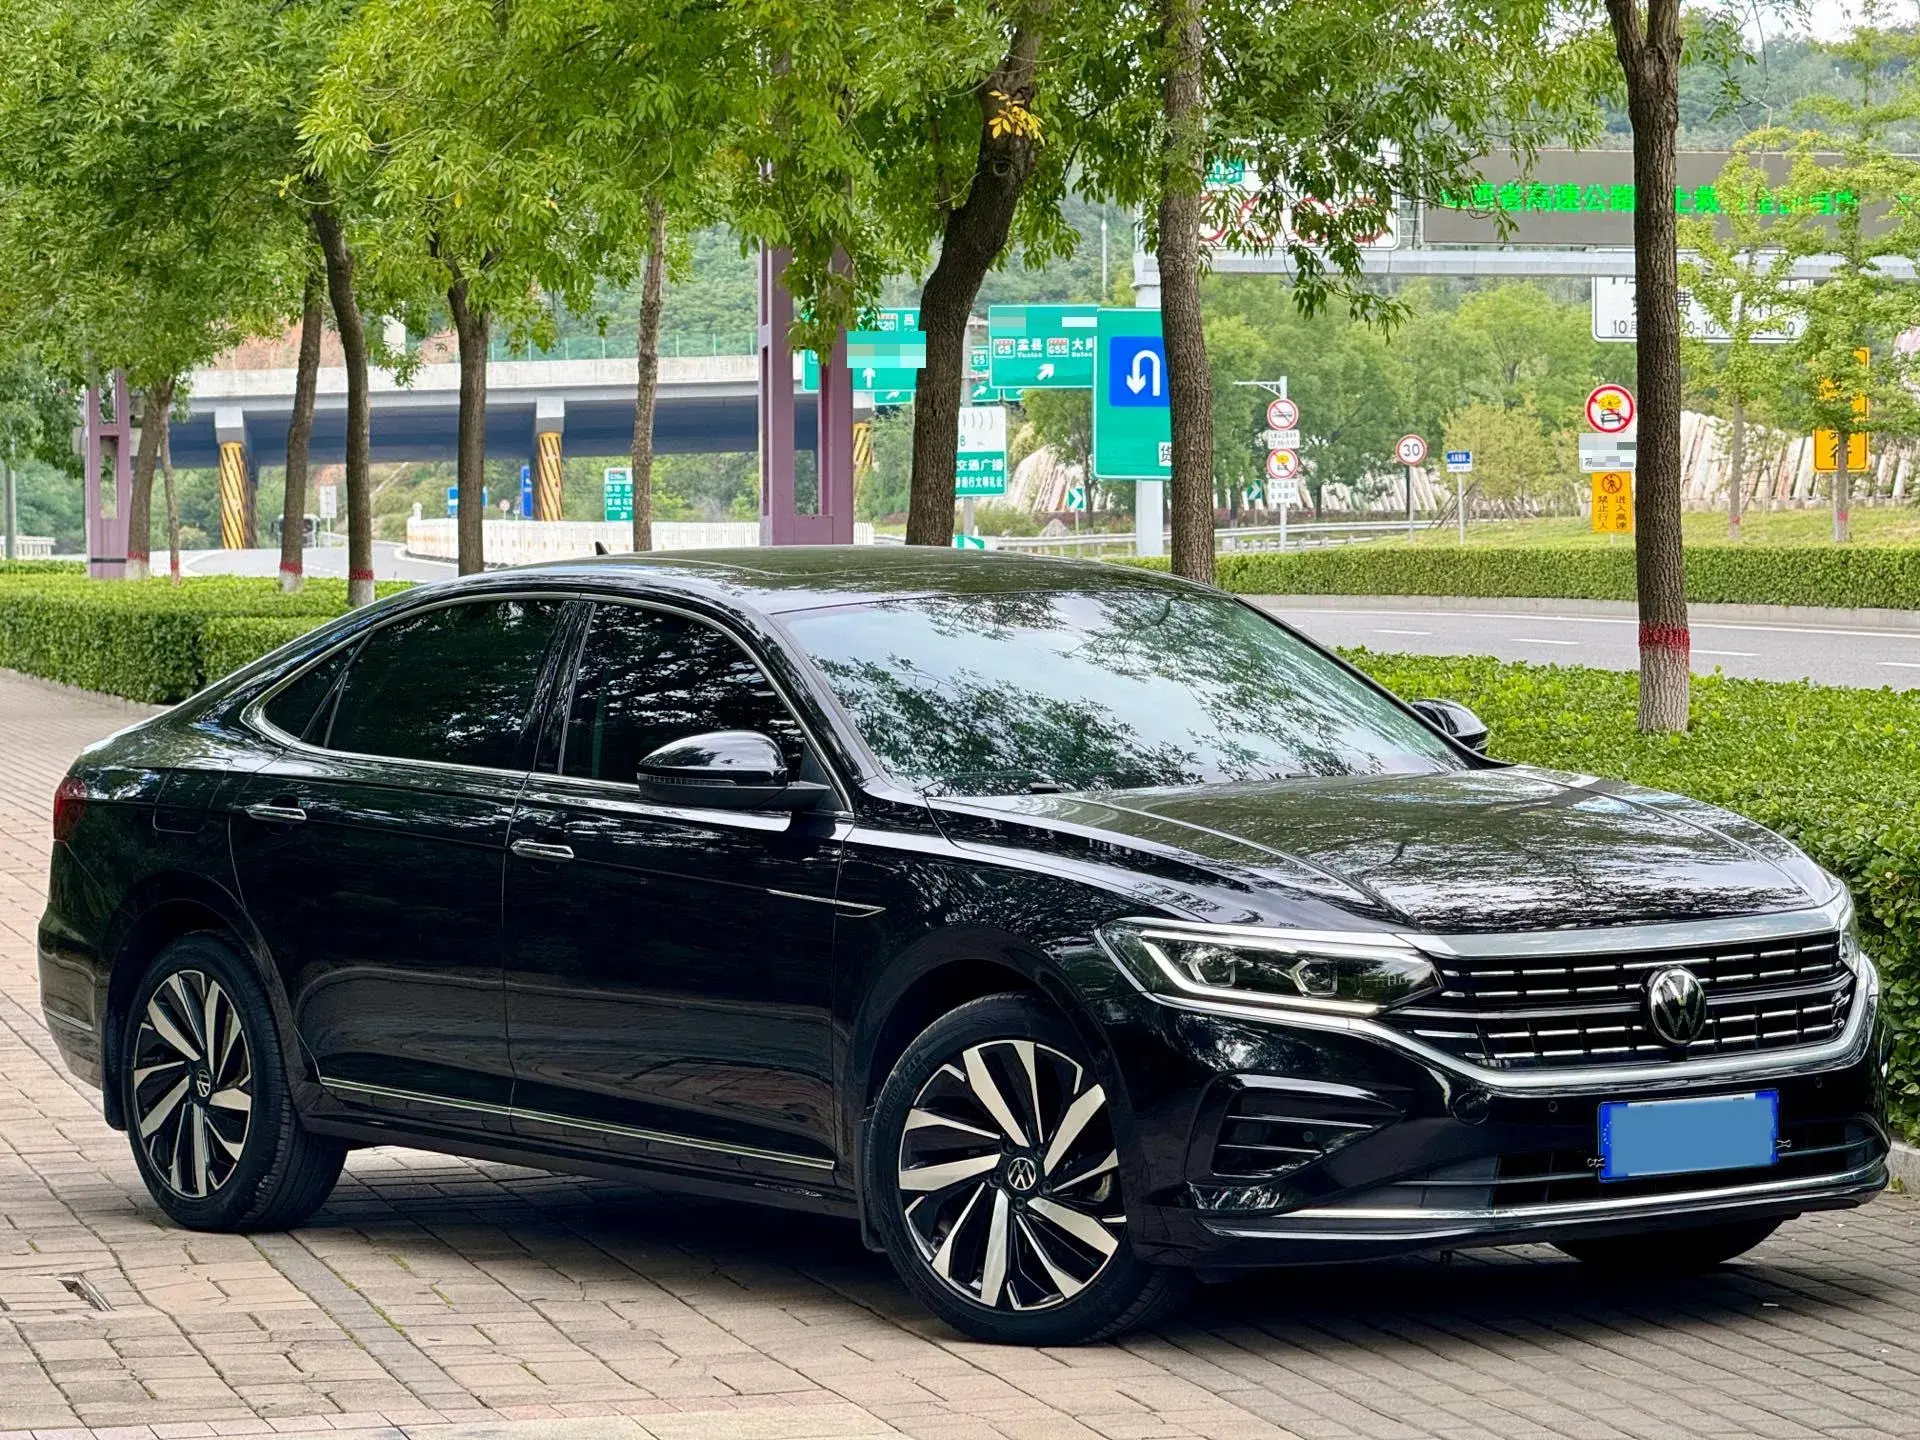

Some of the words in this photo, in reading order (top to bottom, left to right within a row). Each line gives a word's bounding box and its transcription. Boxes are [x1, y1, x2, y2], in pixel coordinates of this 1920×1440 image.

[1048, 345, 1067, 355] G55
[1403, 443, 1420, 457] 30
[1598, 495, 1608, 530] 禁止行人
[1615, 495, 1627, 530] 进入高速
